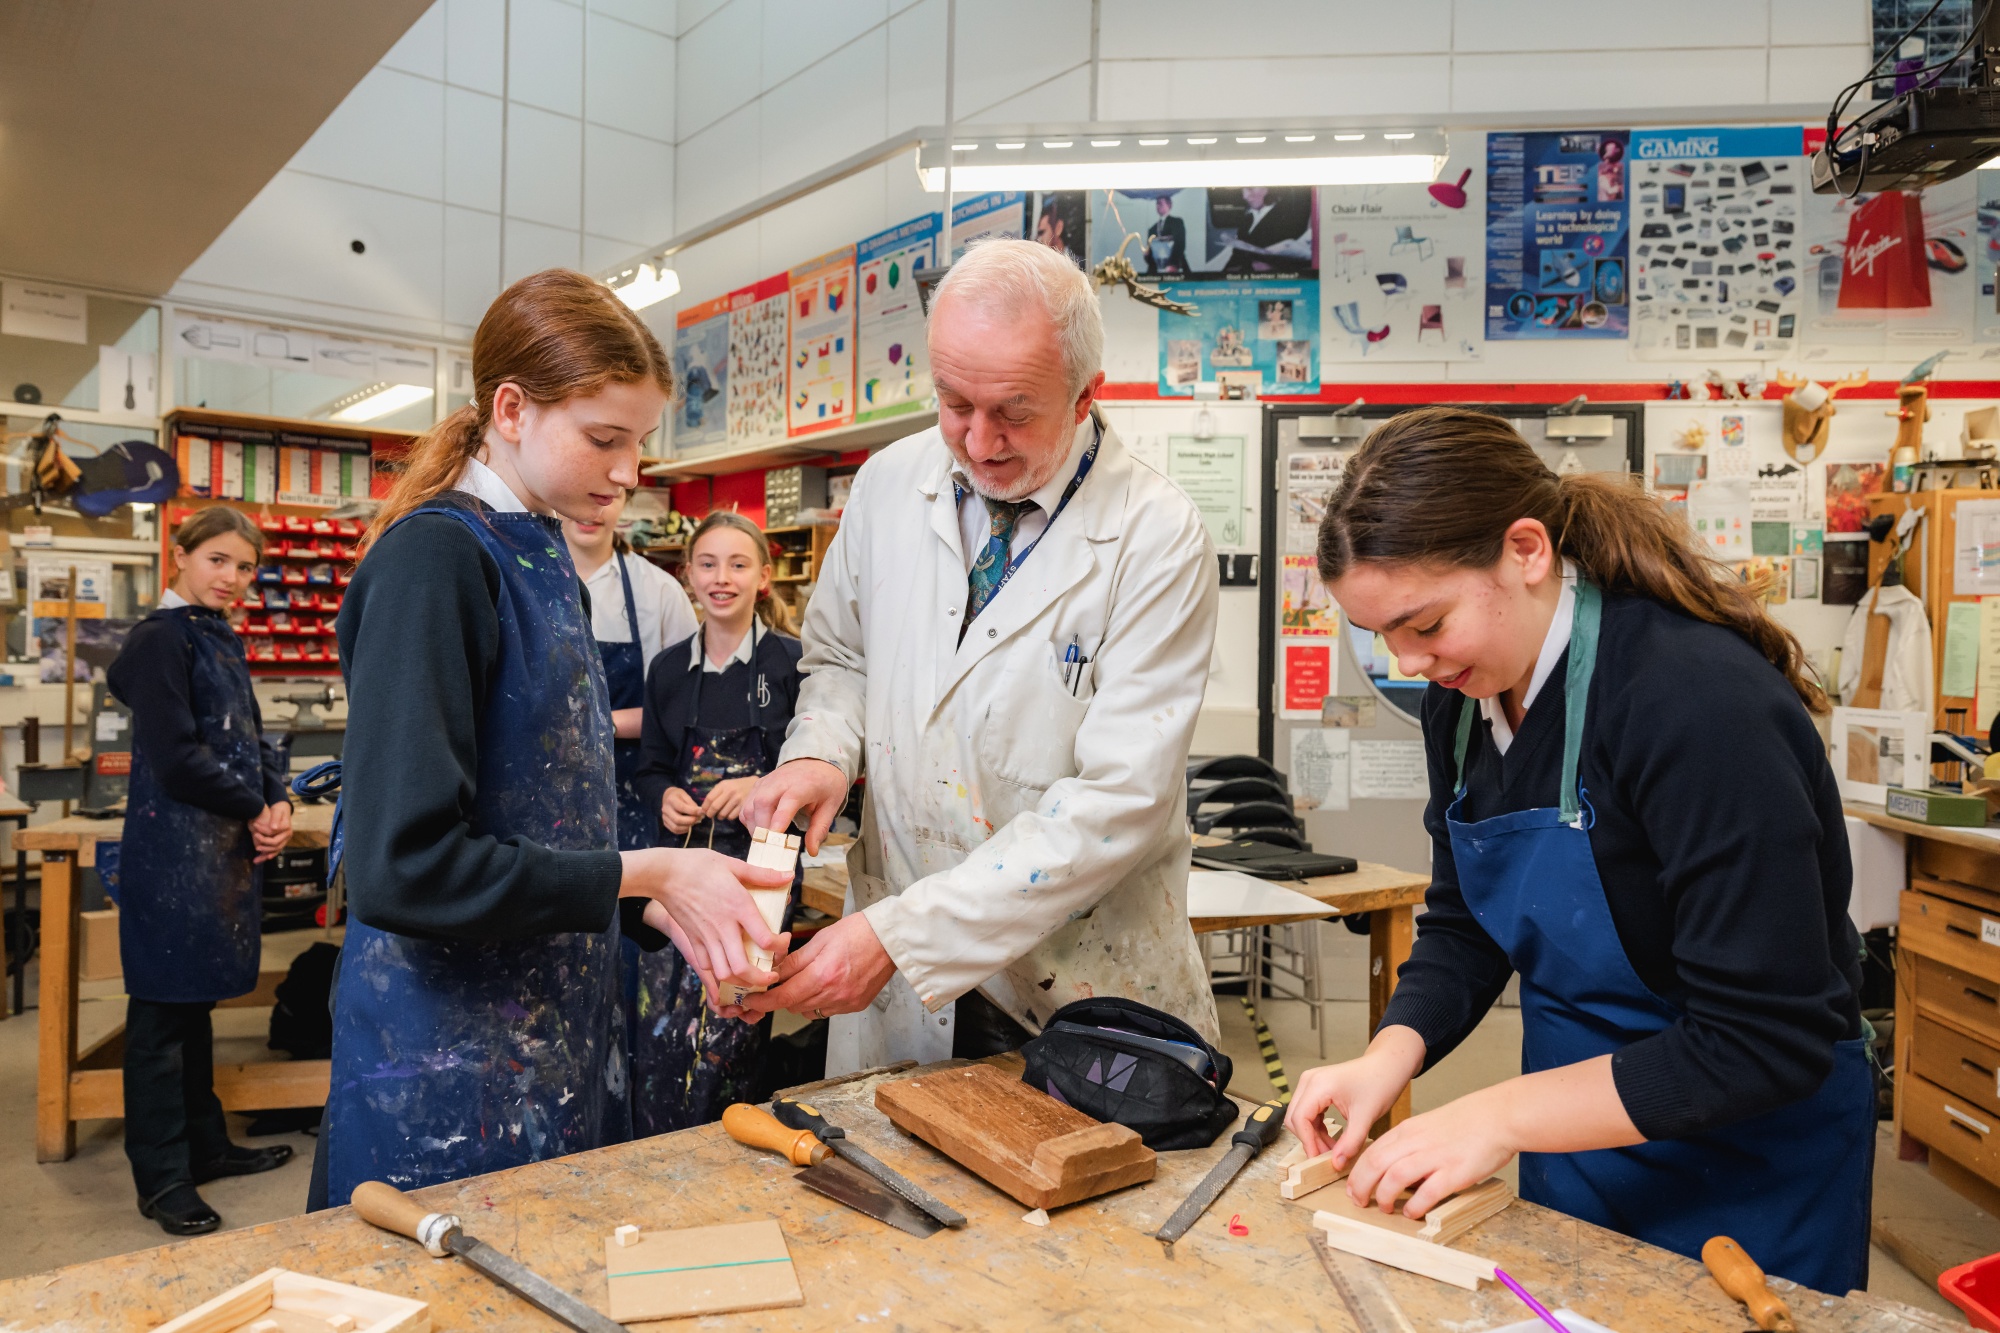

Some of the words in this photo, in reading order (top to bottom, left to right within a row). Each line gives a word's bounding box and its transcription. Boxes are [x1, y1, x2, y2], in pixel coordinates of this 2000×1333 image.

[1638, 141, 1719, 158] GAMING
[1331, 204, 1357, 214] Chair
[1360, 204, 1383, 214] Flair
[1535, 210, 1578, 221] Learning
[1580, 209, 1593, 220] by
[1594, 209, 1621, 221] doing
[1535, 223, 1545, 233] in
[1557, 221, 1618, 233] technological
[1535, 234, 1563, 245] world
[1276, 272, 1299, 280] idea?
[1194, 288, 1239, 297] PRINCIPLES
[1241, 288, 1253, 296] OF
[1254, 287, 1303, 296] MOVEMENT
[221, 427, 274, 441] components
[319, 438, 368, 450] components
[323, 494, 338, 506] and
[998, 565, 1017, 591] STAFF
[1889, 794, 1926, 815] MERITS
[1986, 925, 1996, 938] A4
